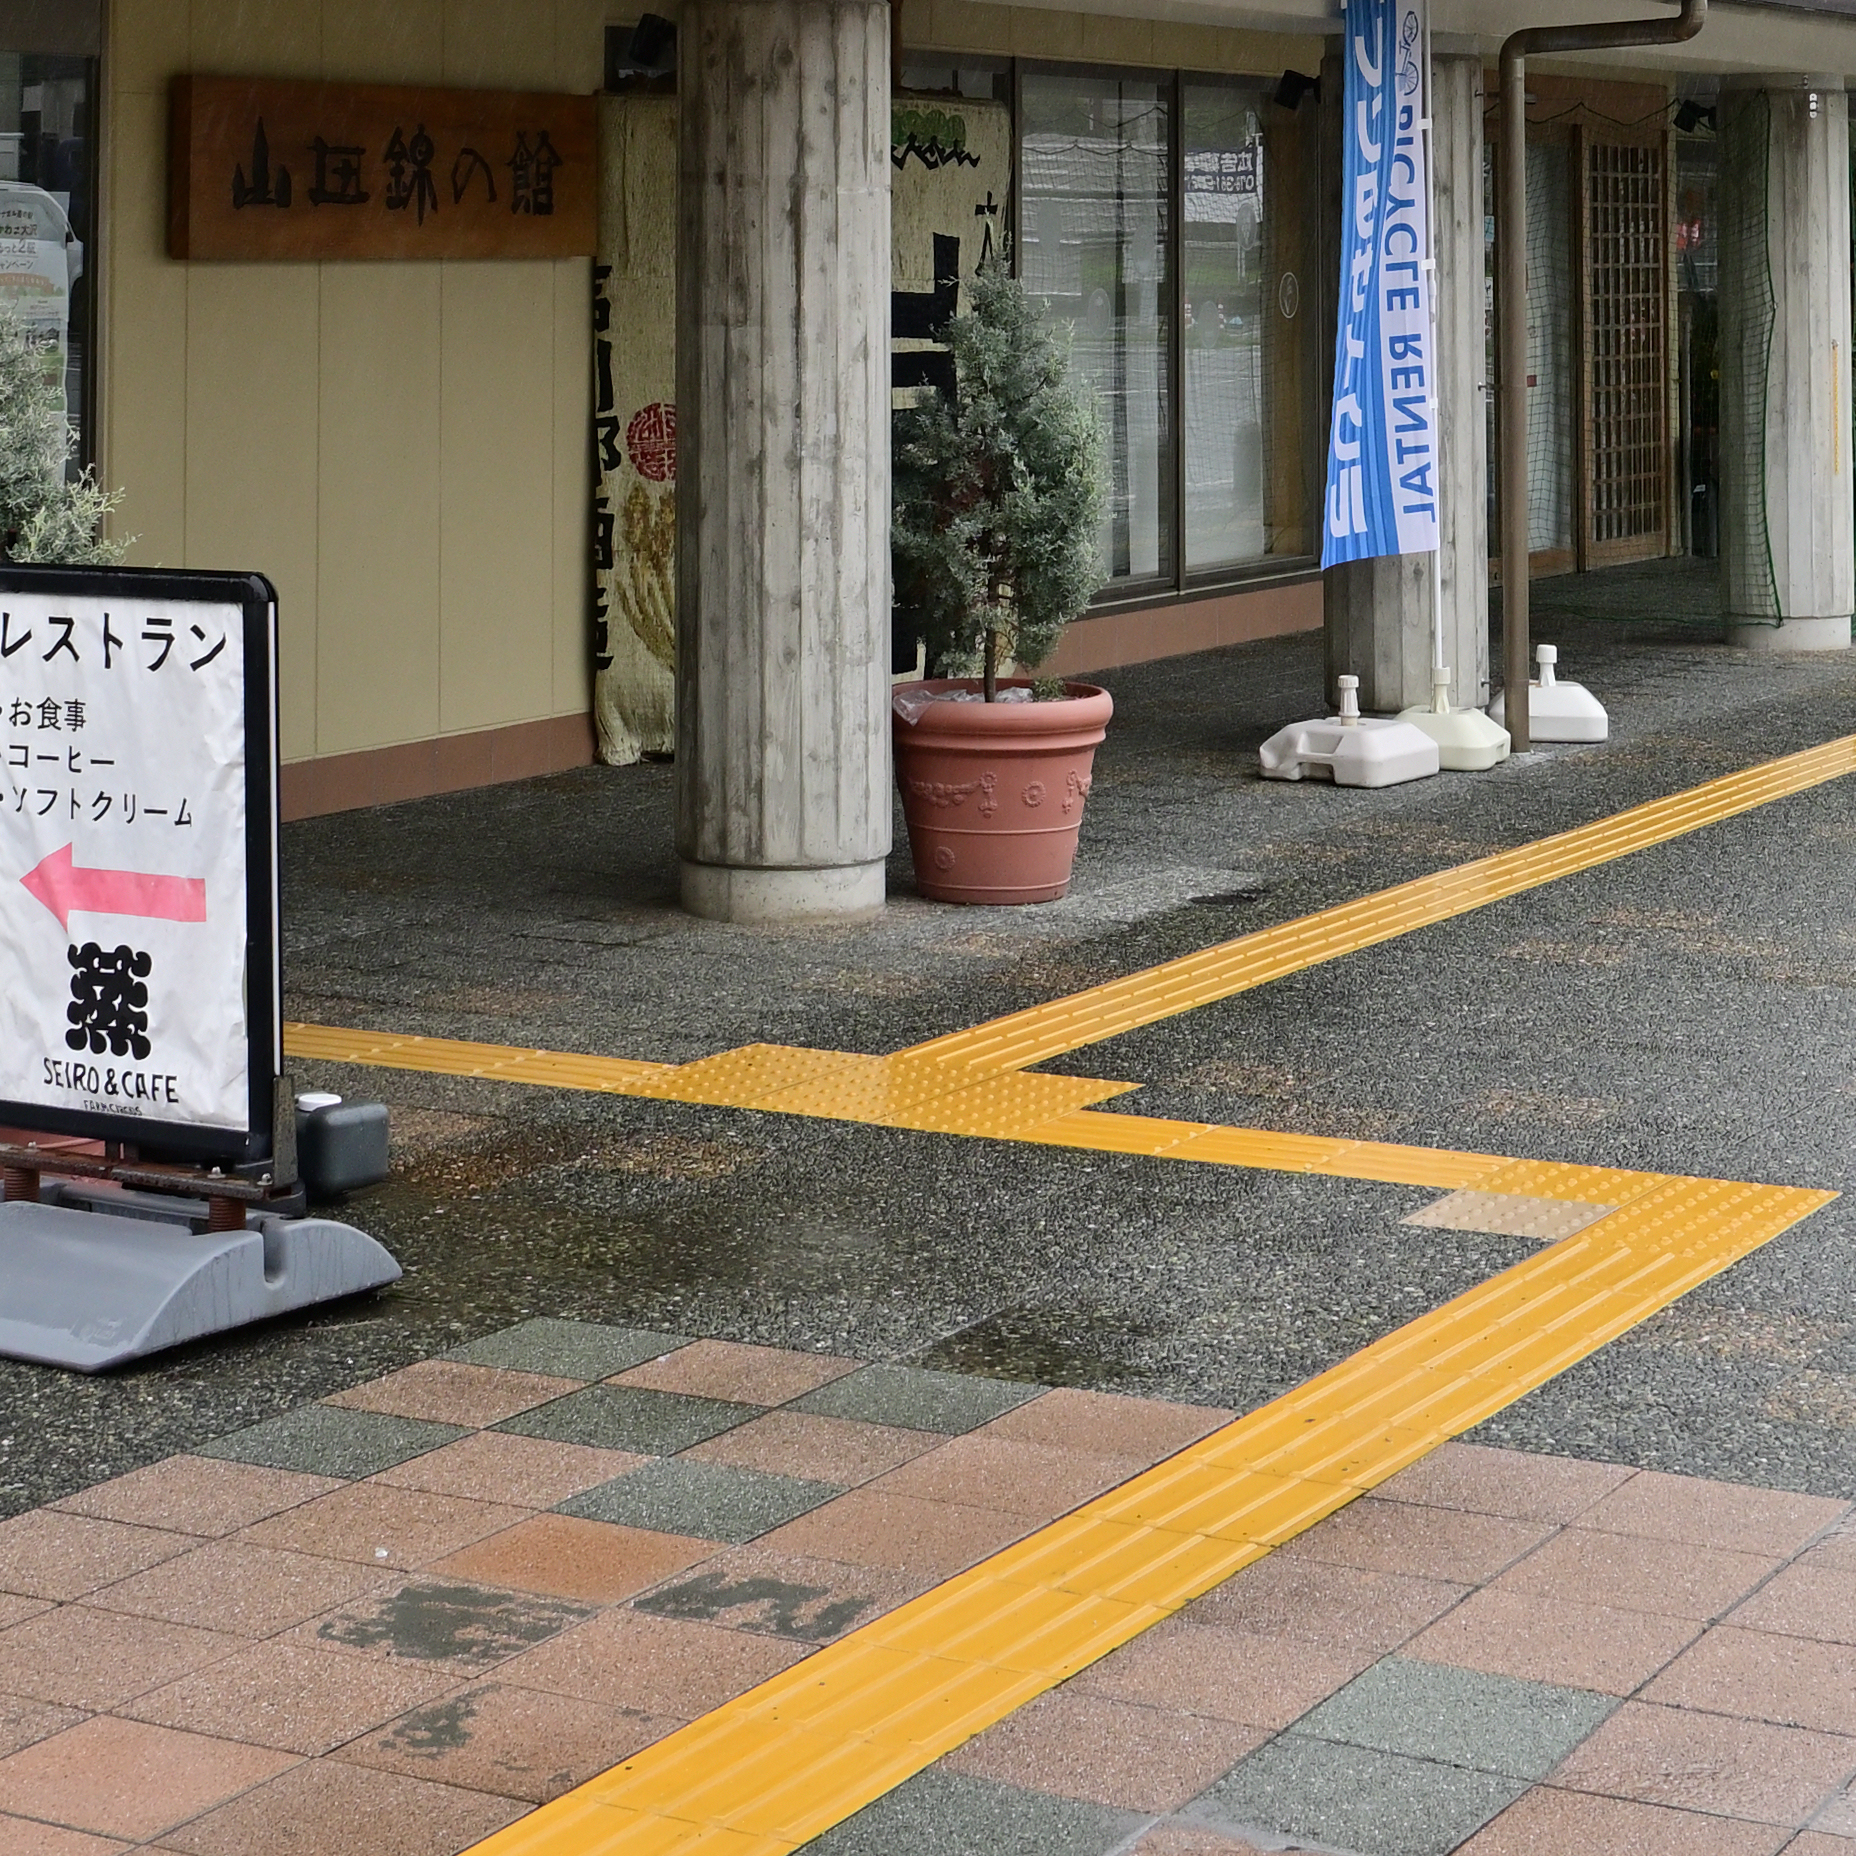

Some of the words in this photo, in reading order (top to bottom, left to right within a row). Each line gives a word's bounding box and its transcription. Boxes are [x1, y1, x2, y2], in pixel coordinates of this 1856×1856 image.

[1, 612, 227, 672] レストラン
